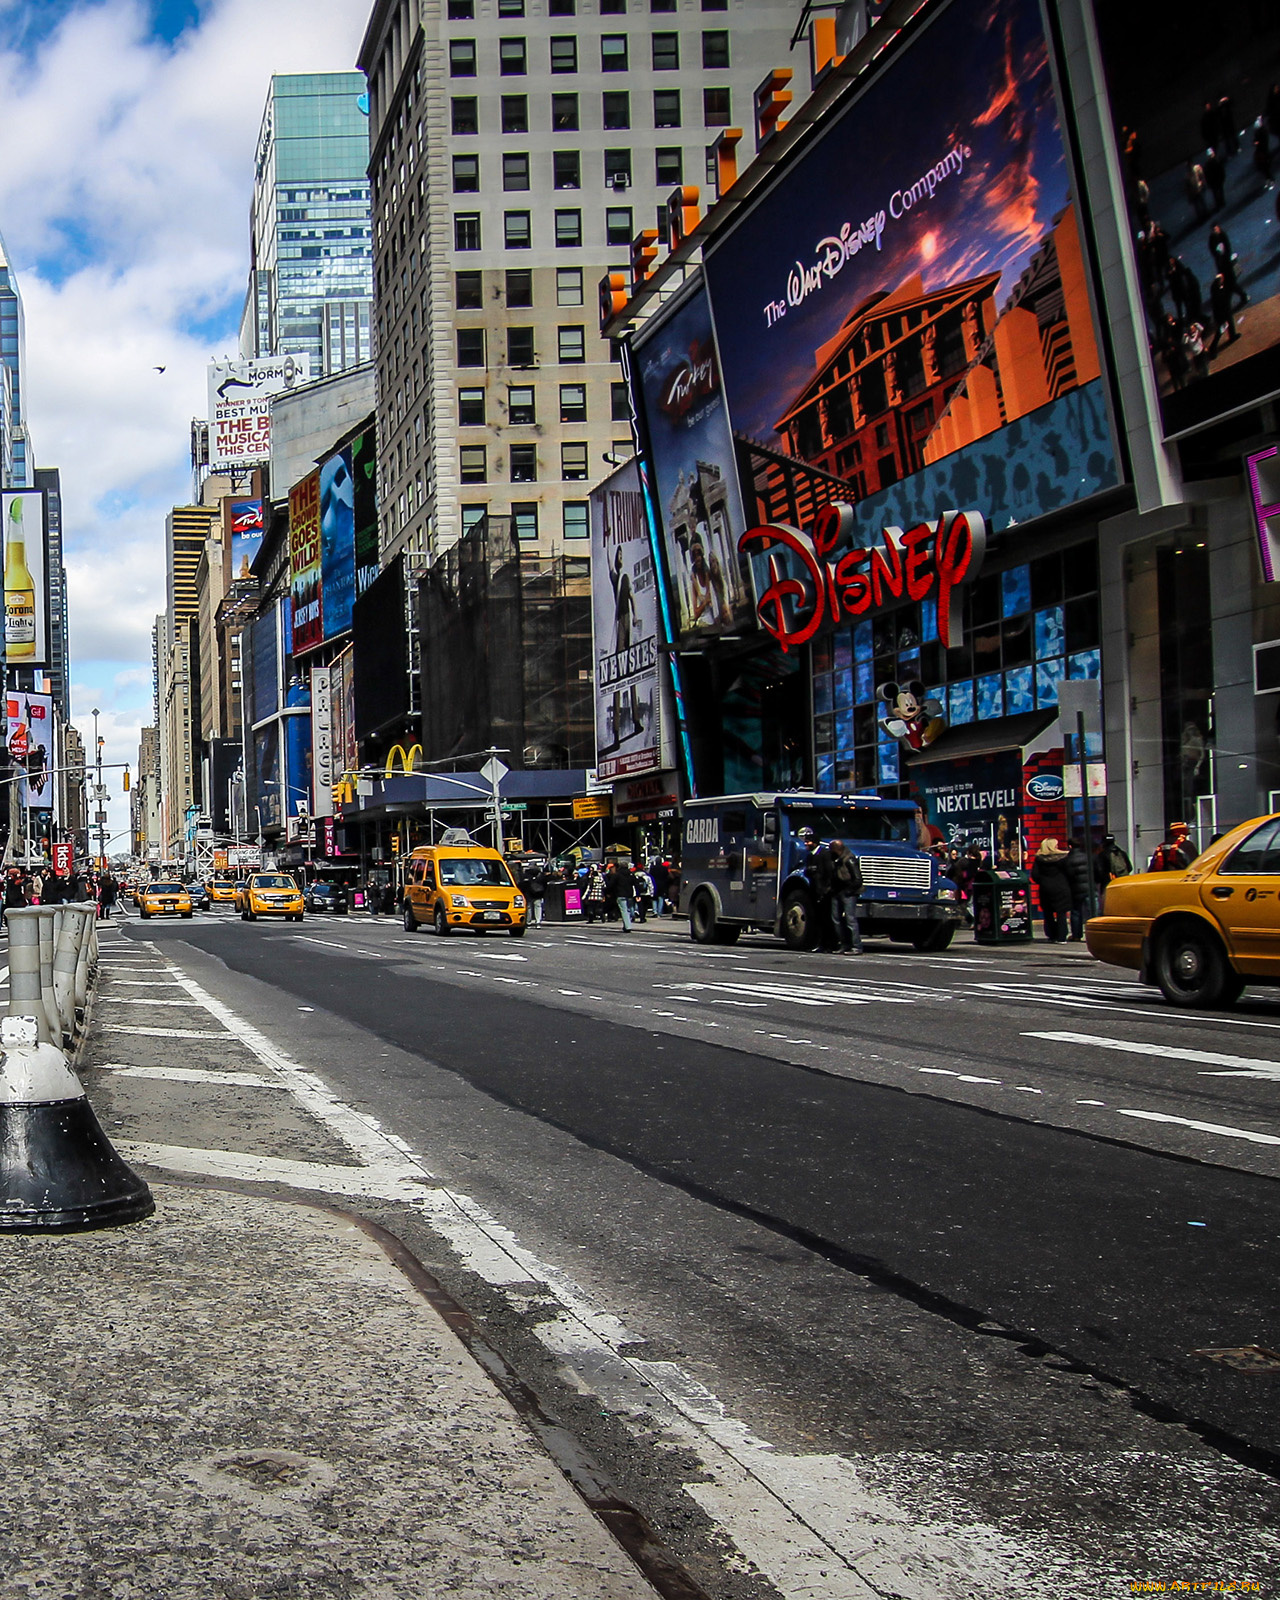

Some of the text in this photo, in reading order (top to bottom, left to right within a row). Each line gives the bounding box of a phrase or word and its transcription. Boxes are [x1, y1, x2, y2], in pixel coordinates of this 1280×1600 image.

[763, 298, 787, 328] The
[667, 357, 713, 405] Turkey
[216, 404, 268, 419] BEST MU
[217, 444, 245, 457] THIS
[291, 474, 318, 516] THE
[291, 506, 318, 532] CROWD
[241, 531, 263, 540] be our
[292, 519, 318, 553] GOES
[292, 537, 320, 574] WILD!
[9, 617, 28, 628] Light
[599, 639, 656, 684] NEWSIES
[936, 788, 1015, 814] NEXT LEVEL!
[938, 785, 954, 793] taking
[658, 809, 674, 818] SONY
[686, 818, 719, 844] GARDA
[57, 845, 69, 869] tkts
